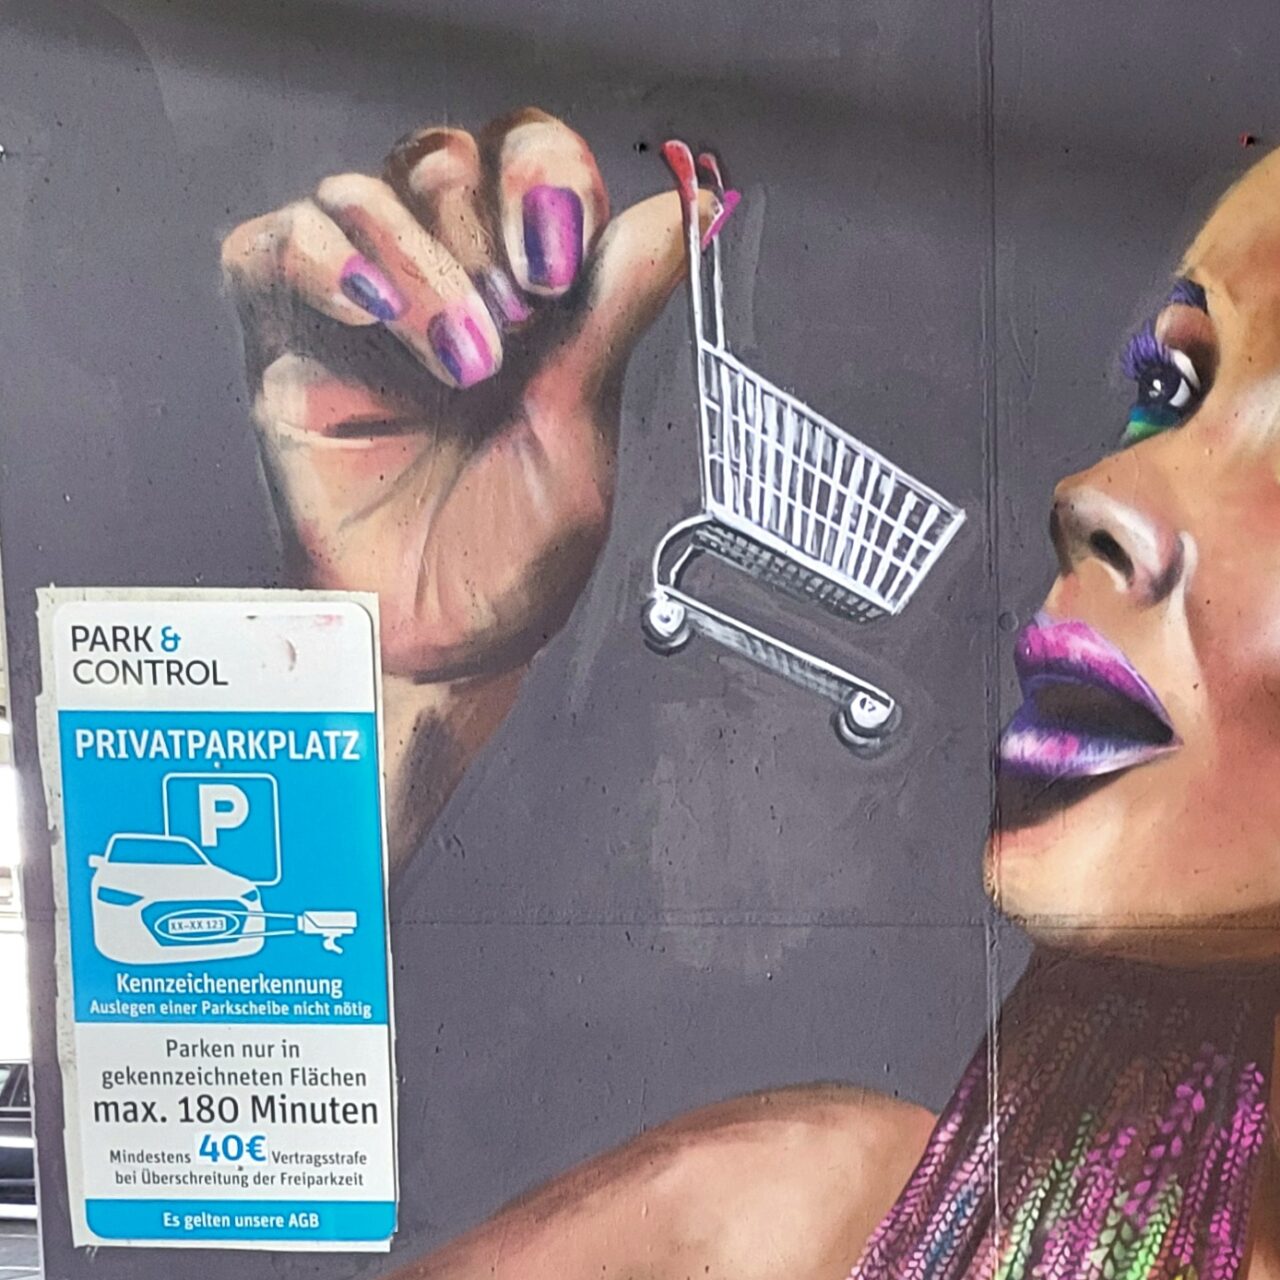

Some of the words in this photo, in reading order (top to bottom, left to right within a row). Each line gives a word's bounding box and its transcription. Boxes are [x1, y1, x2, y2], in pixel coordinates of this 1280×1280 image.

[71, 625, 153, 652] PARK
[160, 625, 181, 652] &
[72, 659, 228, 686] CONTROL
[75, 728, 360, 760] PRIVATPARKPLATZ
[199, 783, 249, 847] P
[116, 972, 343, 999] Kennzeichenerkennung
[90, 1000, 154, 1018] Auslegen
[159, 1001, 197, 1015] einer
[201, 1001, 289, 1016] Parkscheibe
[293, 1001, 330, 1017] nicht
[334, 1002, 372, 1019] nötig
[166, 1038, 235, 1058] Parken
[242, 1043, 275, 1058] nur
[281, 1039, 300, 1058] in
[102, 1066, 283, 1089] gekennzeichneten
[290, 1067, 367, 1087] Flächen
[93, 1100, 167, 1123] max.
[178, 1094, 239, 1124] 180
[251, 1094, 378, 1125] Minuten
[109, 1150, 191, 1164] Mindestens
[199, 1134, 267, 1162] 40€
[272, 1151, 367, 1167] Vertragsstrafe
[115, 1170, 137, 1185] bei
[141, 1168, 249, 1188] Überschreitung
[253, 1171, 275, 1186] der
[280, 1171, 363, 1188] Freiparkzeit
[163, 1212, 180, 1227] Es
[183, 1212, 232, 1230] gelten
[234, 1214, 284, 1228] unsere
[288, 1213, 319, 1228] AGB
